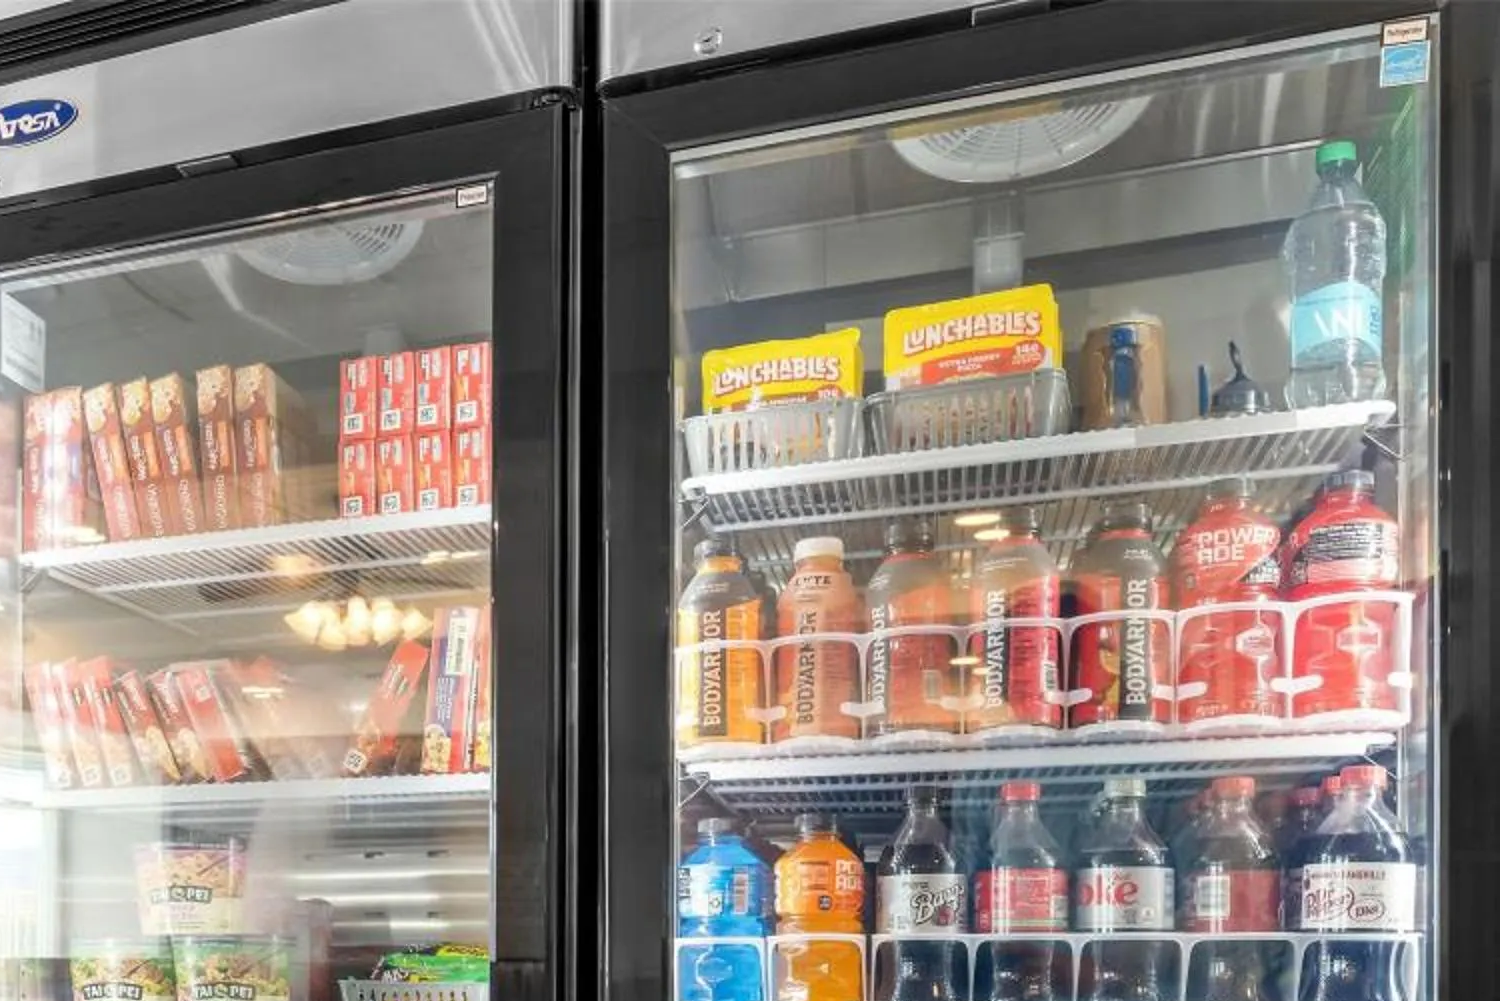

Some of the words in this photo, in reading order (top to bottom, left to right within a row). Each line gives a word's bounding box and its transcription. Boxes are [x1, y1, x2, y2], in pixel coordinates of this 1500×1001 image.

[903, 310, 1041, 356] LUNCHABLES
[712, 355, 841, 396] LUNCHABLES
[1198, 526, 1276, 549] POWER
